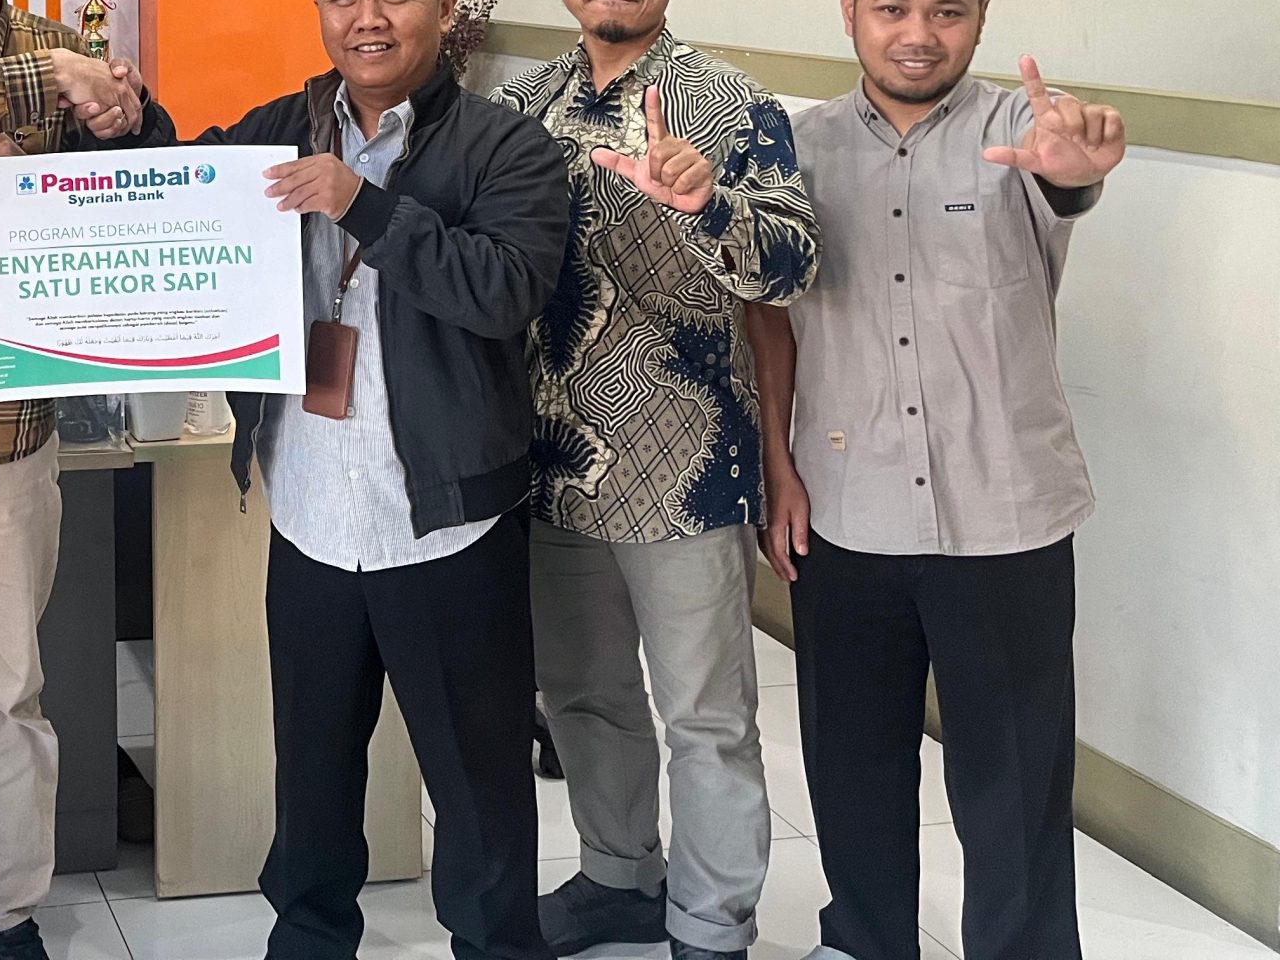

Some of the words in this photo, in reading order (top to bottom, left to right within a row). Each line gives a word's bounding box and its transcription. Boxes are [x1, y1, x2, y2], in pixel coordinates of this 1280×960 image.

[41, 166, 190, 193] PaninDubai
[68, 193, 123, 207] Syariah
[128, 189, 165, 202] Bank
[9, 226, 84, 242] PROGRAM
[89, 222, 157, 238] SEDEKAH
[162, 219, 223, 234] DAGING
[159, 245, 253, 267] HEWAN
[18, 278, 81, 300] SATU
[91, 274, 156, 295] EKOR
[163, 272, 217, 292] SAPI
